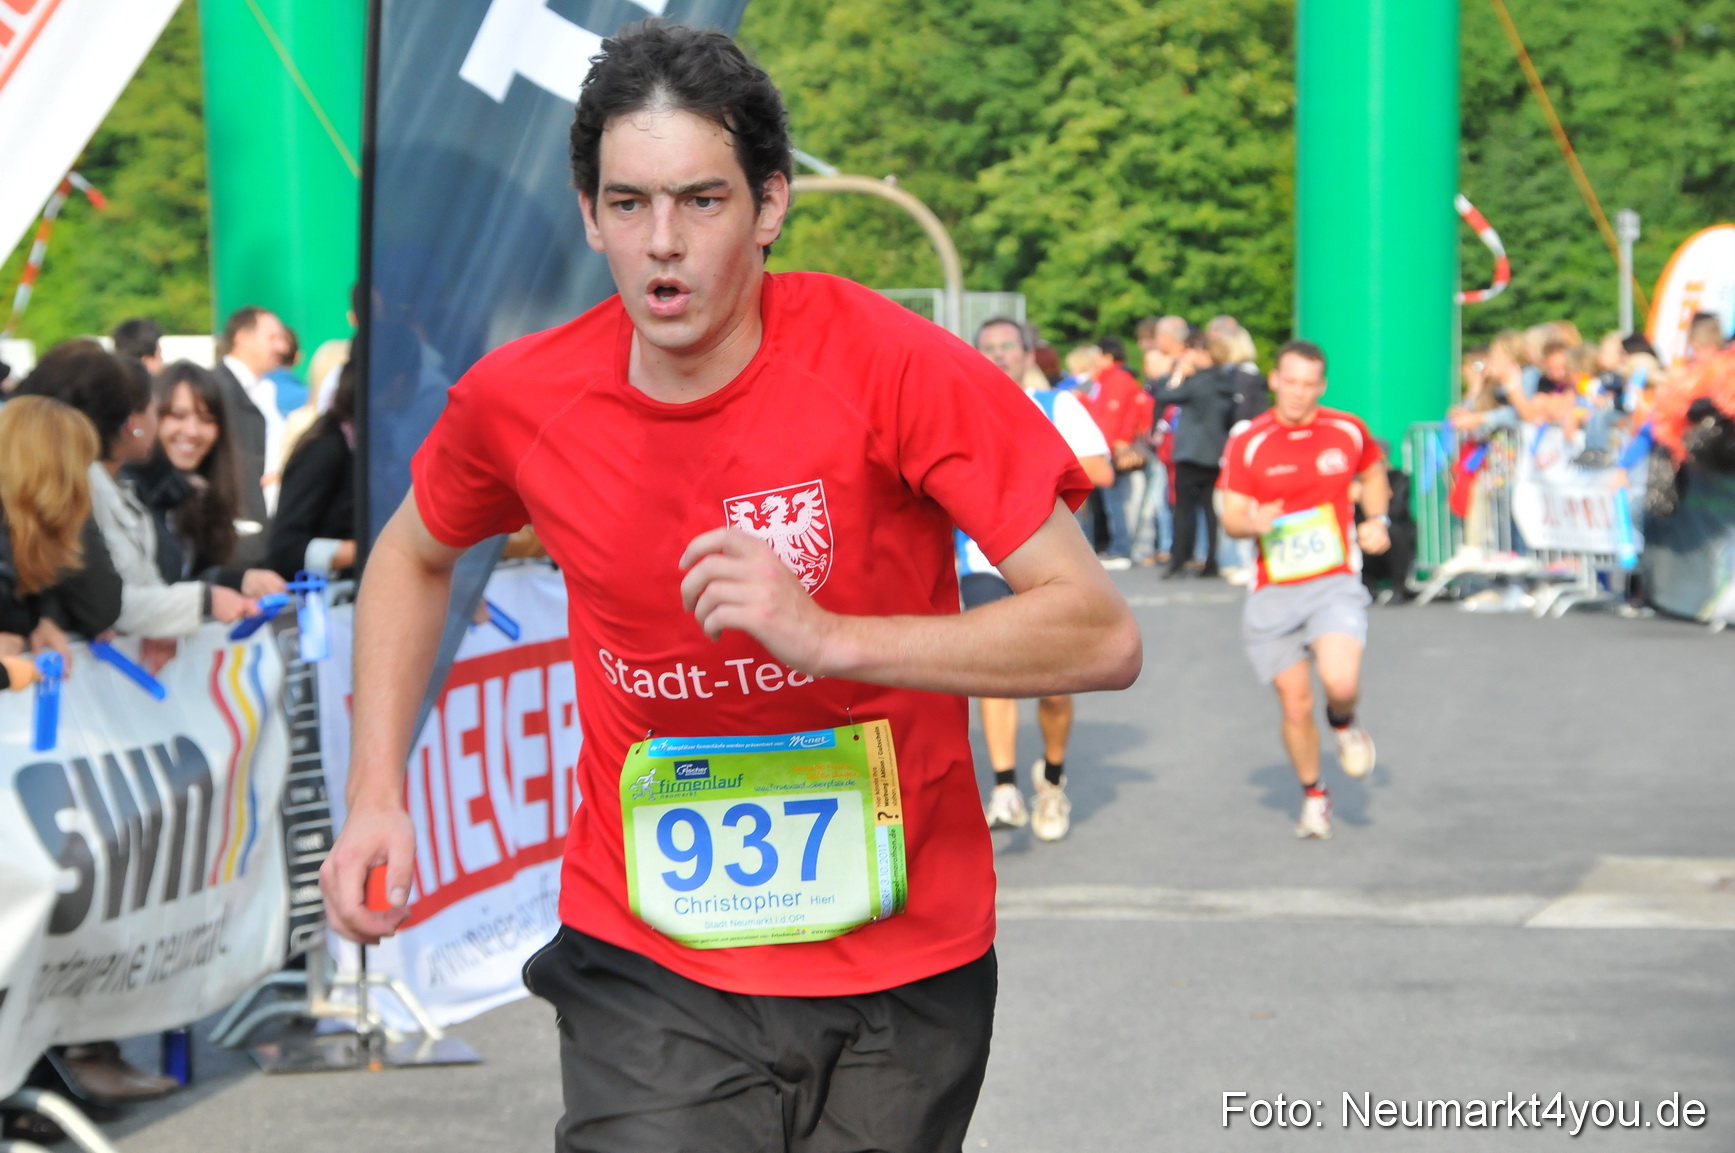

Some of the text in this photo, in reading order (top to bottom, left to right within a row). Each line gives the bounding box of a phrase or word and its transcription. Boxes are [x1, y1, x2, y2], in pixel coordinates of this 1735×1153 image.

[598, 648, 828, 700] Stadt-Tea
[660, 773, 744, 794] firmenlauf
[656, 798, 839, 892] 937
[674, 891, 835, 914] Christopher Hierl
[704, 919, 728, 929] Stadt
[730, 917, 773, 928] Neumarkt
